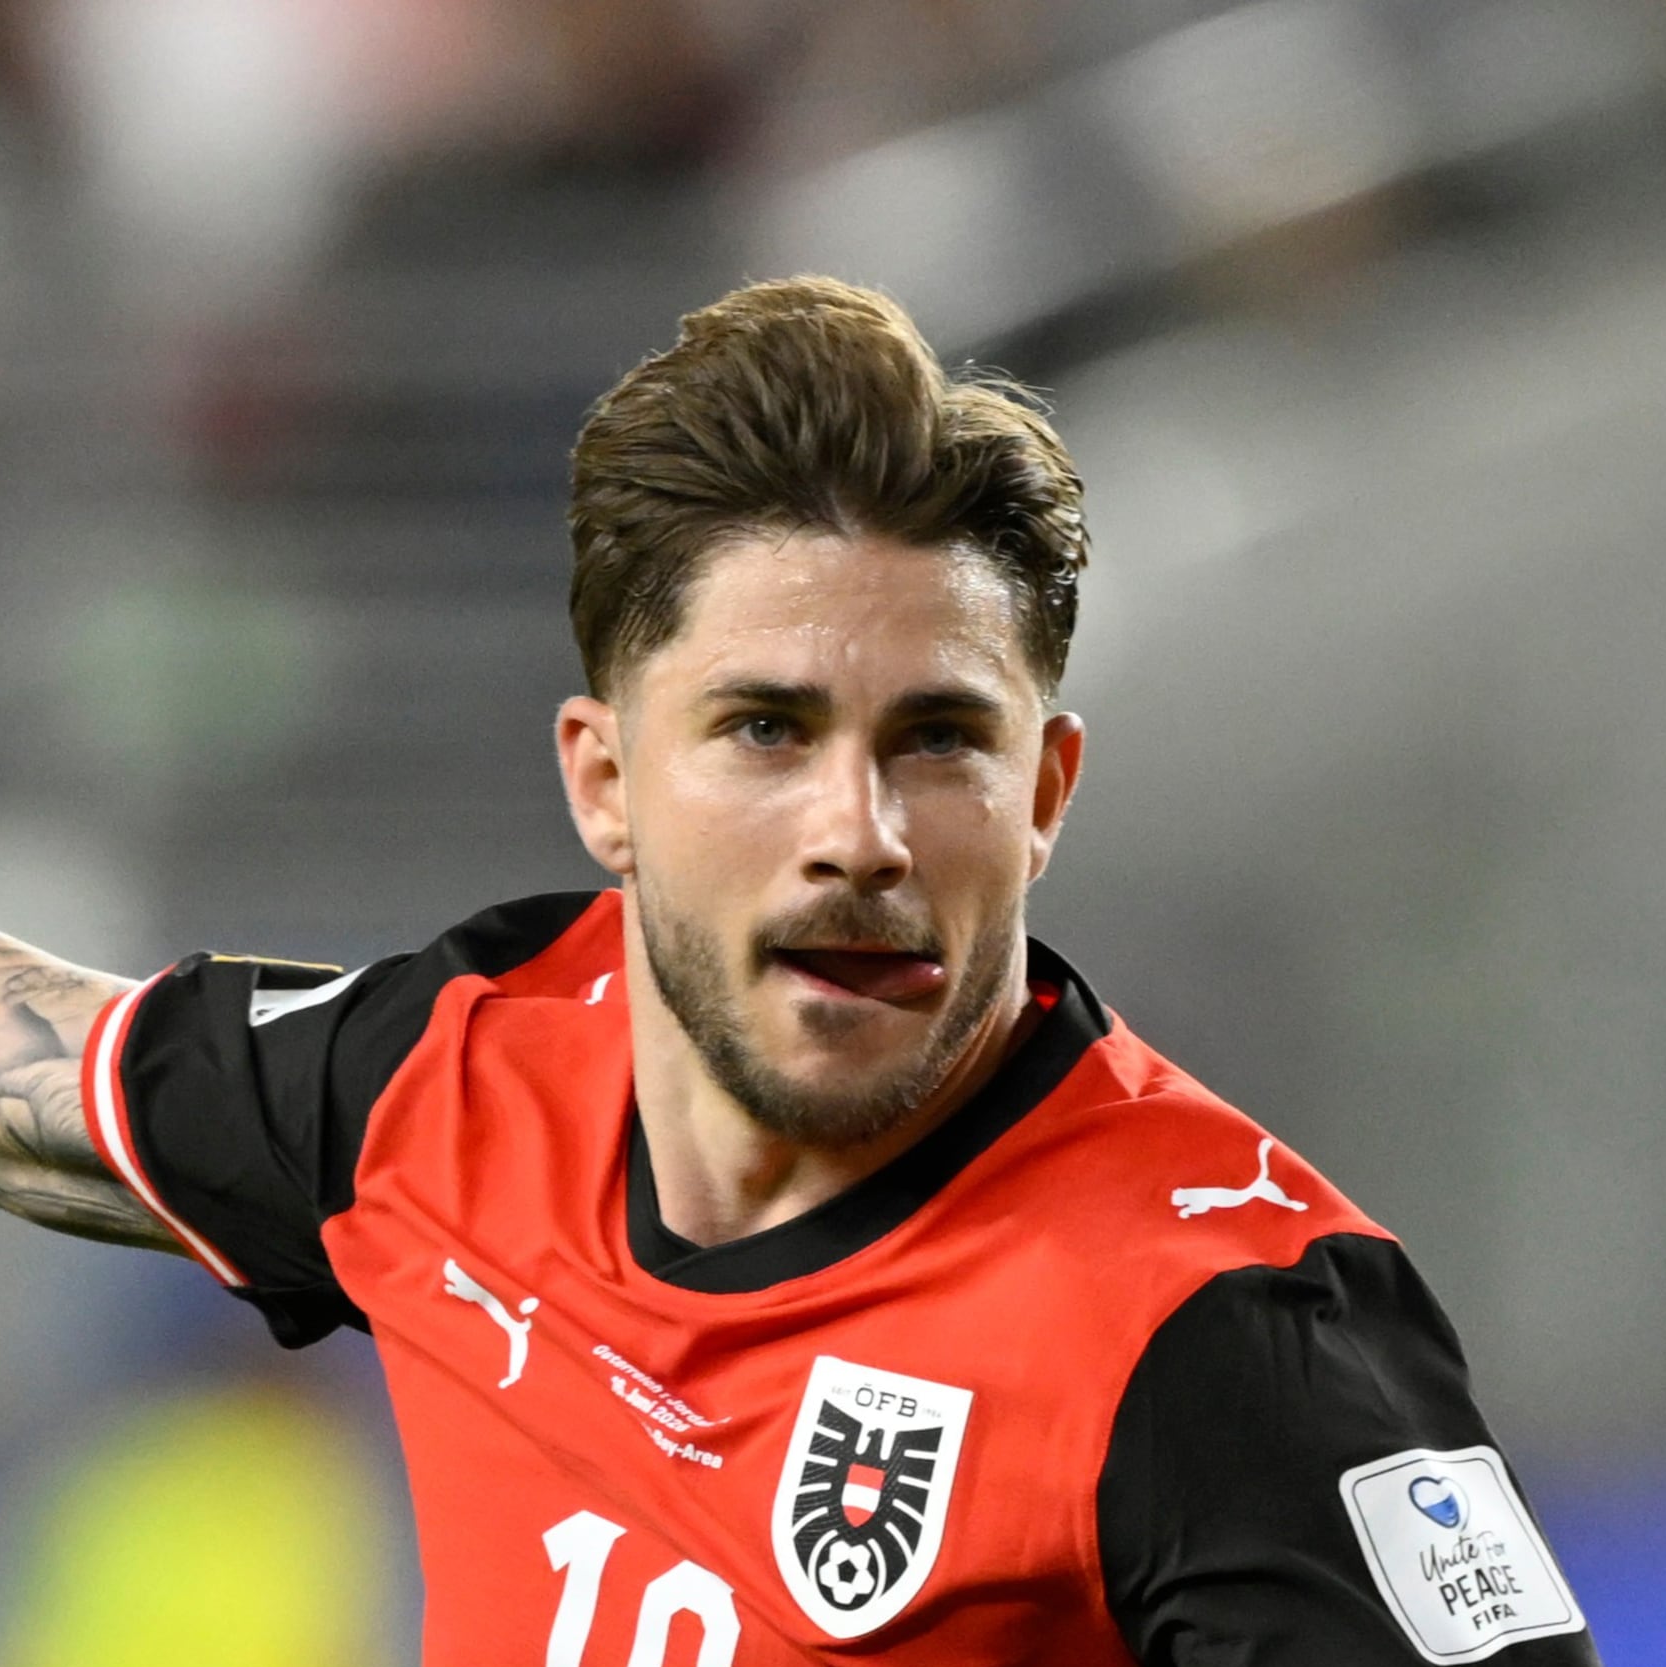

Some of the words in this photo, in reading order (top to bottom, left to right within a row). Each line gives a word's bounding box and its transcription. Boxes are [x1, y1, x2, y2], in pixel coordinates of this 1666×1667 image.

[855, 1383, 918, 1418] ÖFB
[1420, 1534, 1480, 1582] Unite
[1439, 1565, 1523, 1616] PEACE
[1472, 1604, 1517, 1631] FIFA
